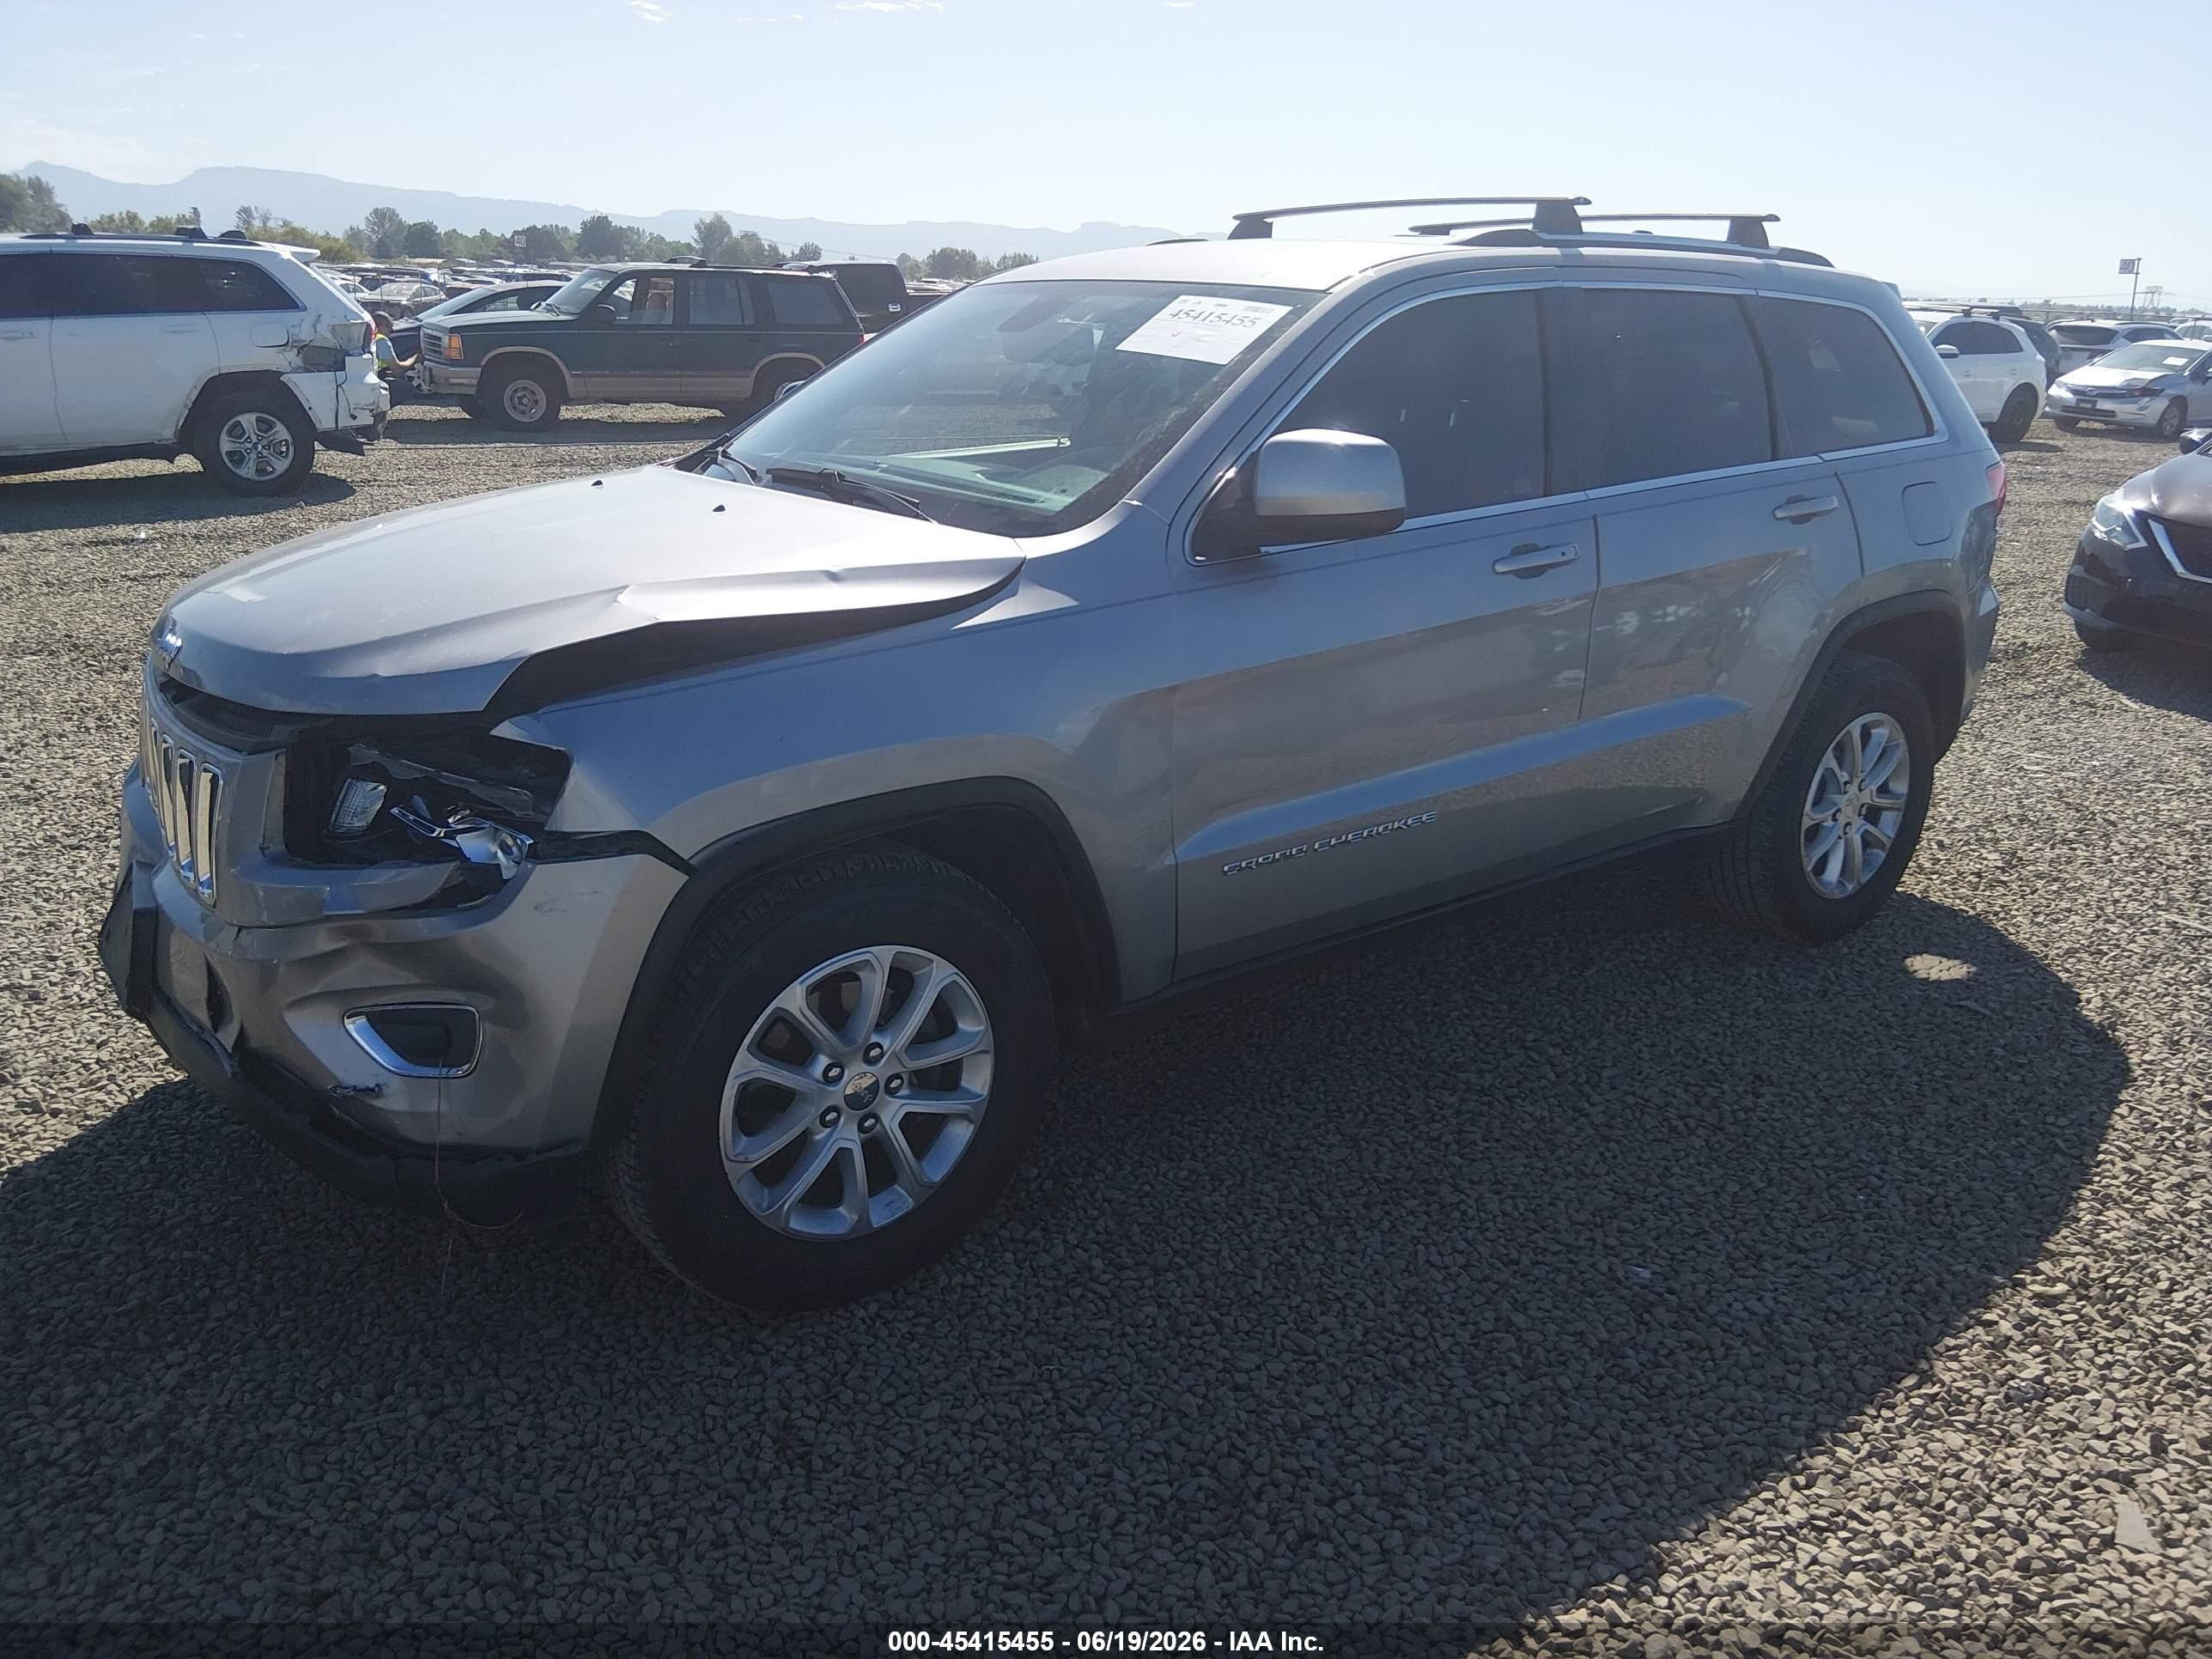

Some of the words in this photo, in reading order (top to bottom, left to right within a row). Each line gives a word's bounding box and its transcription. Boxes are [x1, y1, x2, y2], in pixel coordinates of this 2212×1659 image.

[515, 236, 526, 246] 40
[1168, 308, 1262, 328] 45415455
[1222, 844, 1309, 876] GRAND
[1313, 811, 1437, 852] CHEROKEE
